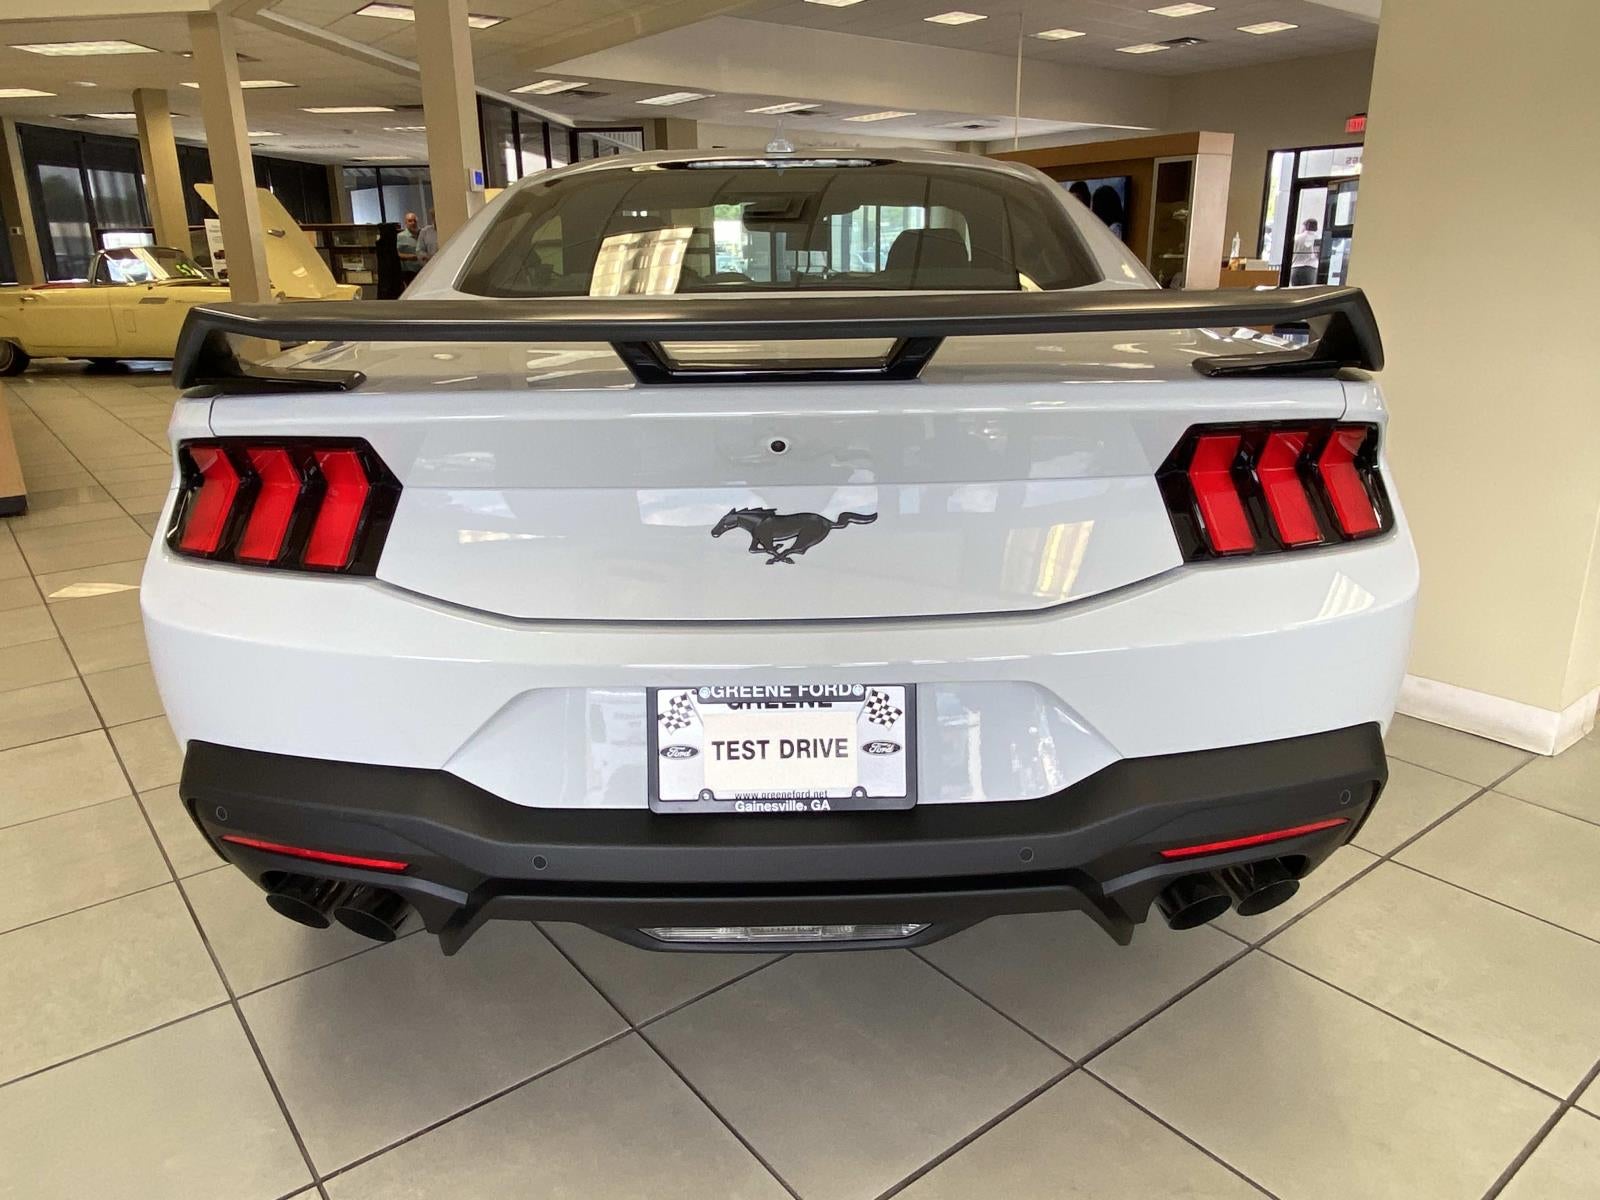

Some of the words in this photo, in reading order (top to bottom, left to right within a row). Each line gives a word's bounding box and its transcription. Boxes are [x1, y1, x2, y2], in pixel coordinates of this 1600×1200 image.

[710, 685, 791, 698] GREENE
[798, 684, 852, 697] FORD
[711, 740, 770, 761] TEST
[779, 738, 849, 759] DRIVE
[735, 800, 807, 812] Gainesville,
[810, 799, 831, 811] GA
